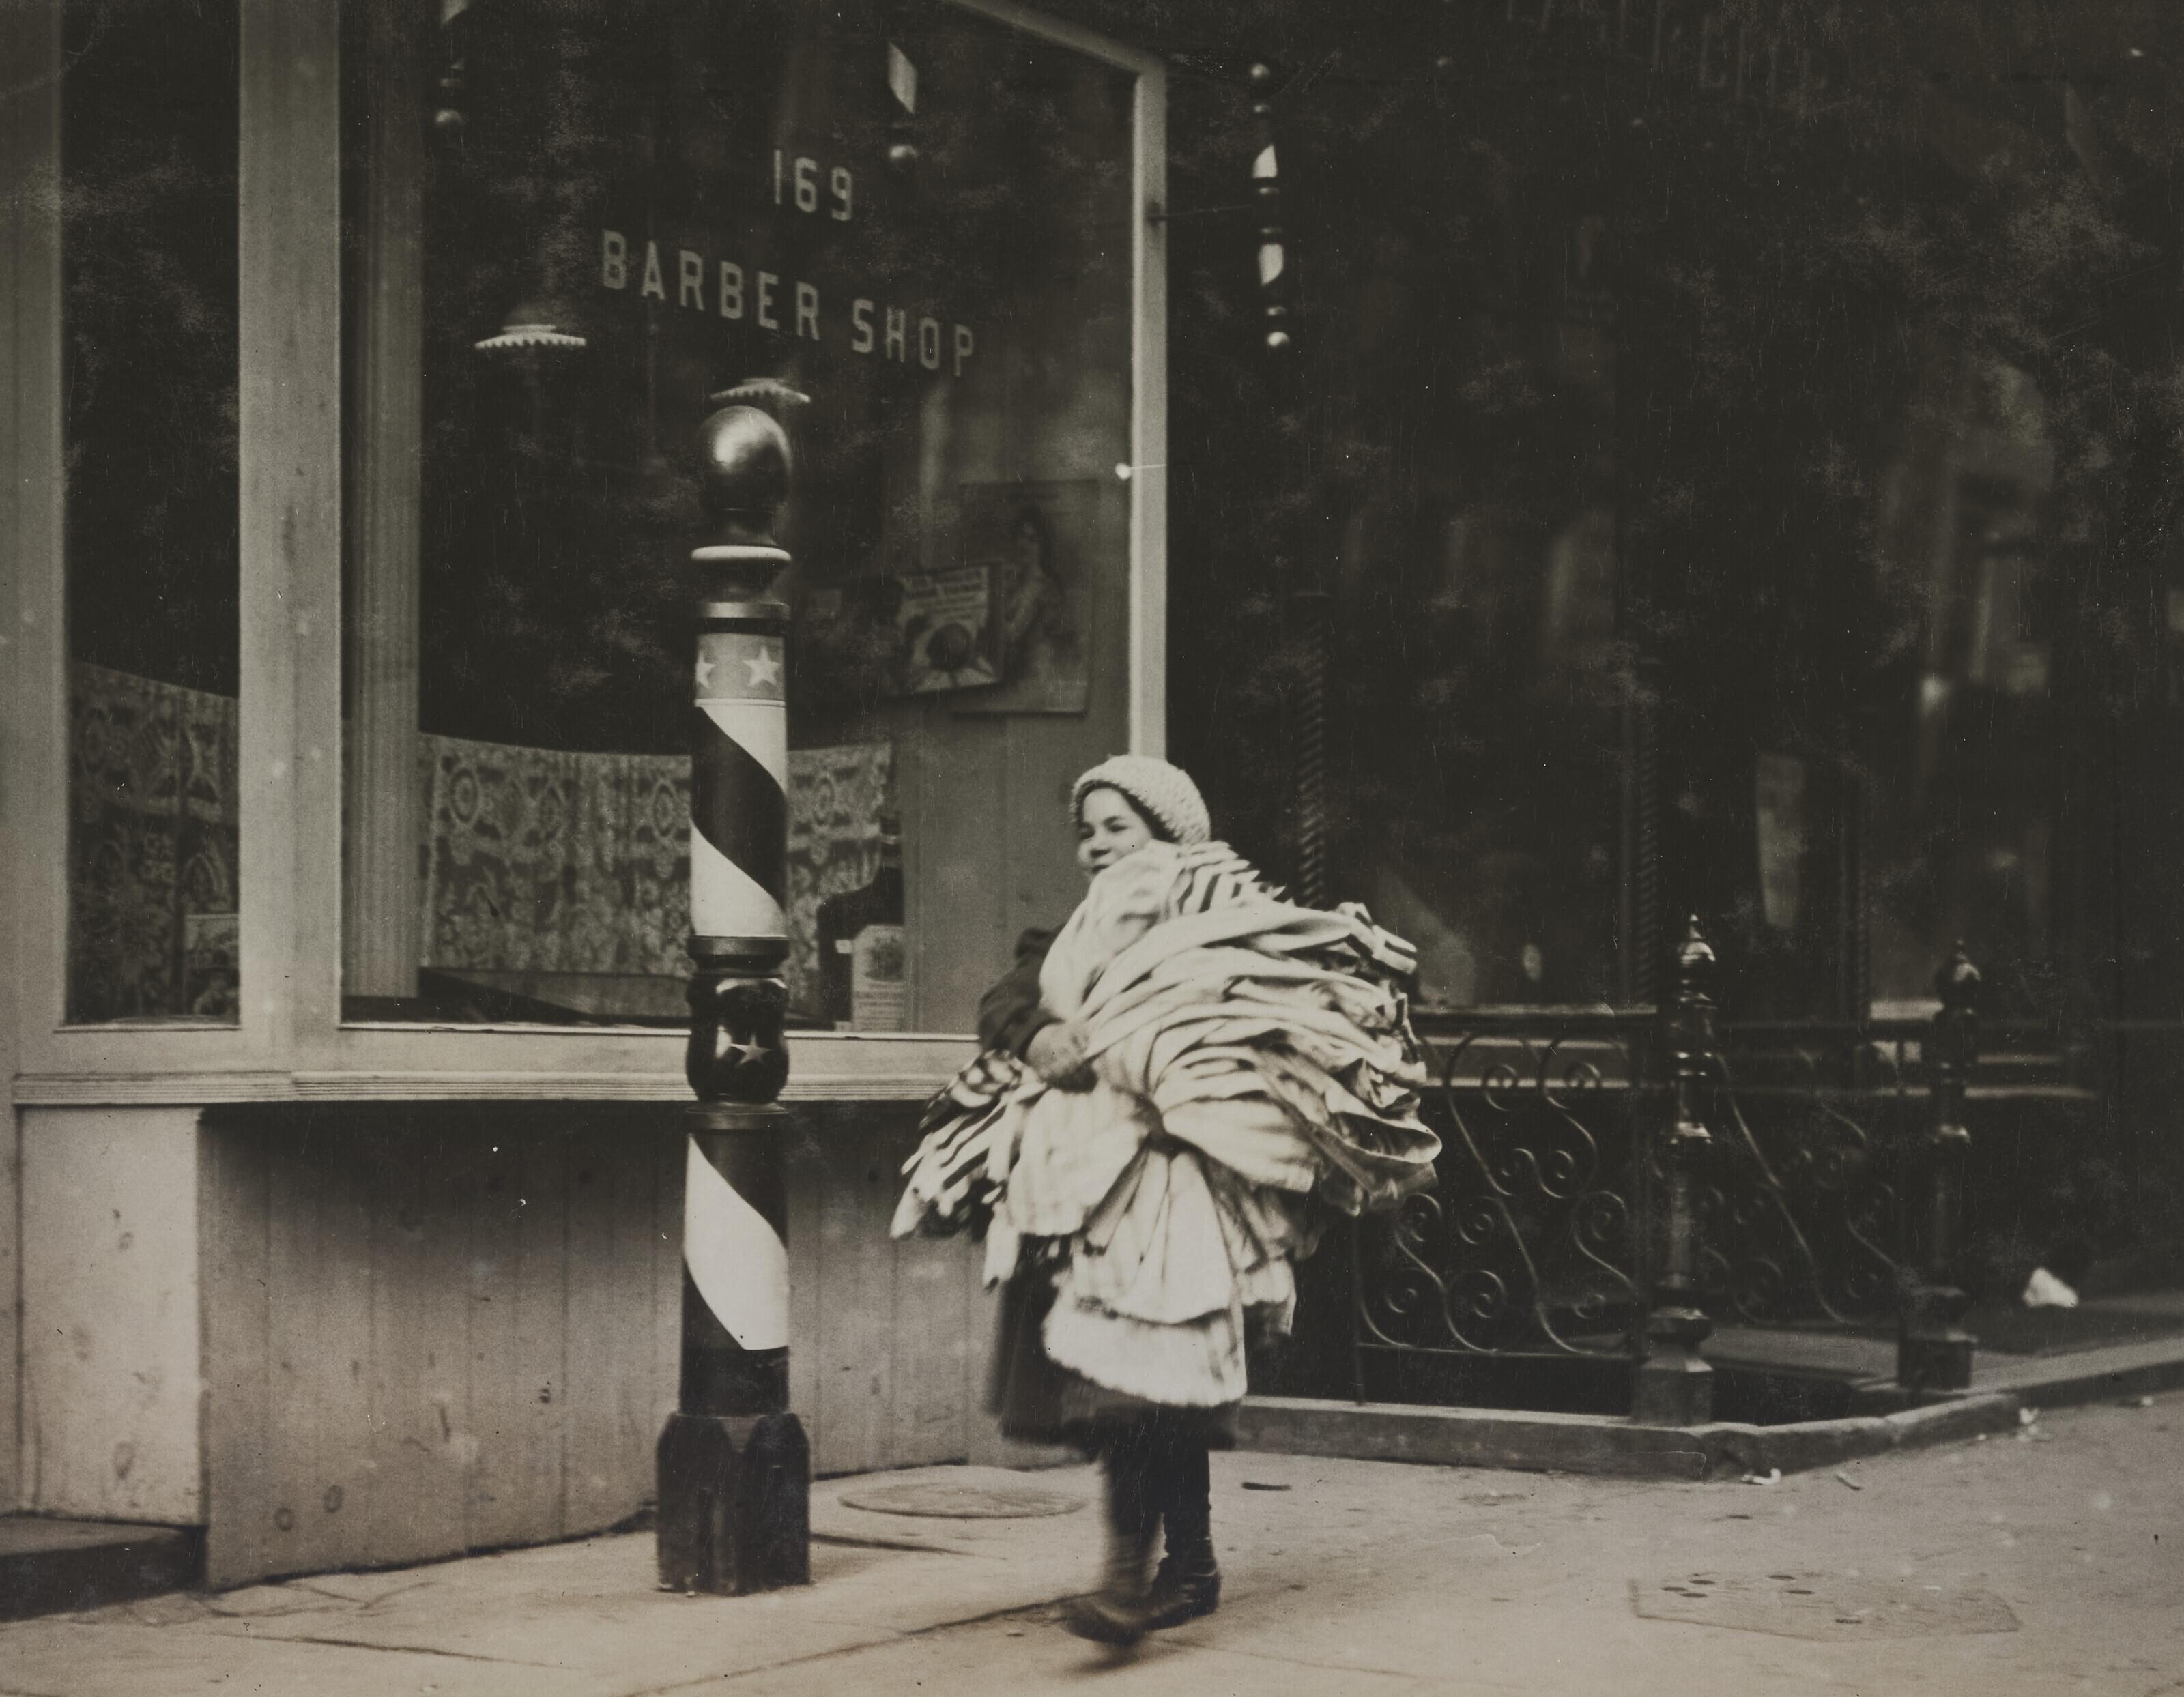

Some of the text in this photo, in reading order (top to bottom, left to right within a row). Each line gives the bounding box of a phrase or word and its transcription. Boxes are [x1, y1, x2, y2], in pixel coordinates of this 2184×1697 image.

[773, 149, 852, 221] 169
[601, 229, 973, 377] BARBER SHOP
